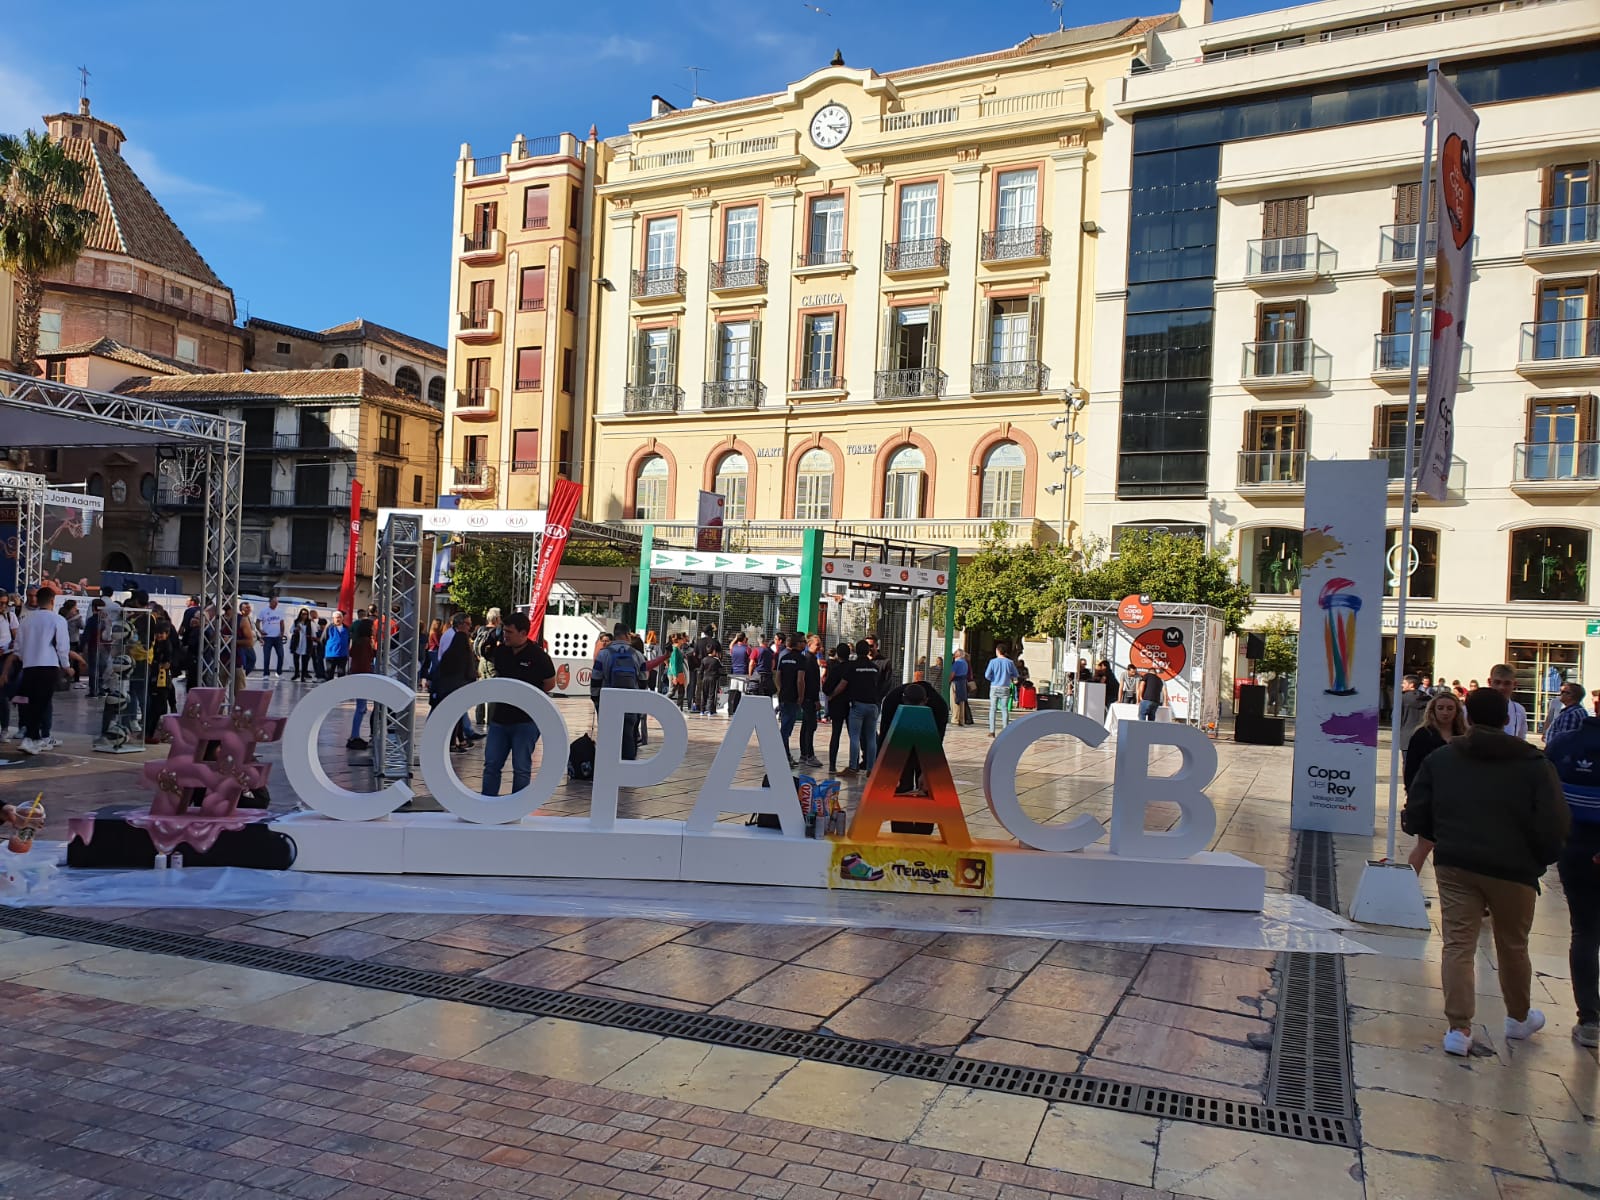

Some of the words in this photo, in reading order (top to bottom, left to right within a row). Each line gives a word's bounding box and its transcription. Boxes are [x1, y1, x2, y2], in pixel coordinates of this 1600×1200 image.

[801, 292, 844, 307] CLINICA
[847, 444, 877, 455] TORRES
[51, 493, 71, 503] Josh
[71, 496, 102, 508] Adams
[544, 544, 554, 558] The
[538, 558, 550, 582] Power
[1140, 649, 1167, 660] Copa
[1152, 659, 1170, 670] Rey
[1307, 765, 1351, 781] Copa
[847, 704, 1218, 860] ACB
[1327, 782, 1356, 798] Rey
